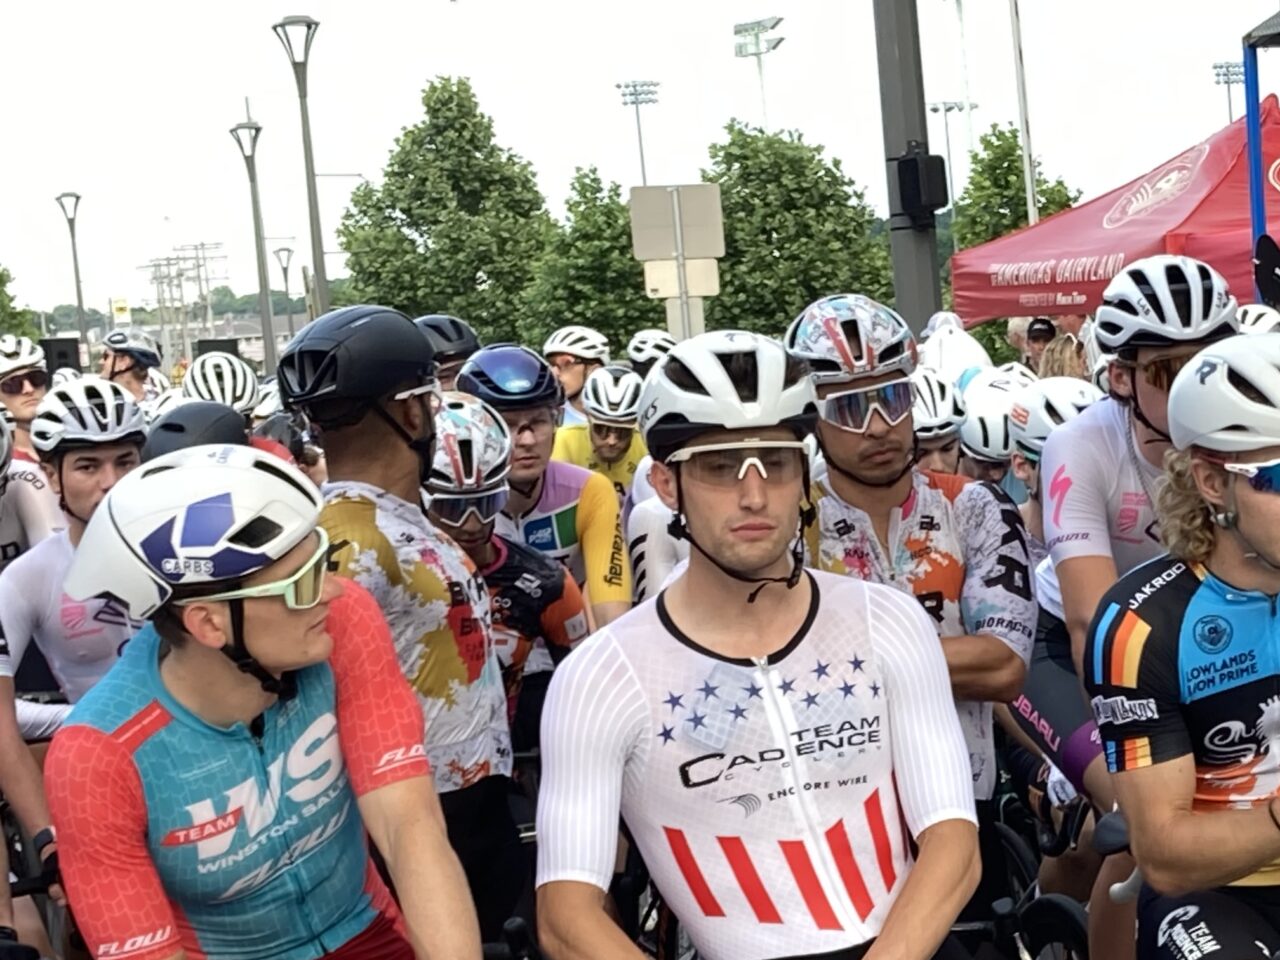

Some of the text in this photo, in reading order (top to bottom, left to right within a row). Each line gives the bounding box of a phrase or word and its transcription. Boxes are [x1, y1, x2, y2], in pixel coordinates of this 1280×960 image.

[162, 558, 213, 574] CARBS
[1127, 561, 1187, 611] JAKROO
[1186, 661, 1259, 697] LION PRIME
[1187, 650, 1257, 684] LOWLANDS
[790, 715, 880, 742] TEAM
[678, 730, 882, 789] CADENCE
[767, 774, 868, 802] ENCORE WIRE
[175, 815, 236, 845] TEAM
[197, 772, 350, 875] WINSTON SALE
[97, 925, 171, 956] FLOW
[1187, 920, 1222, 955] TEAM
